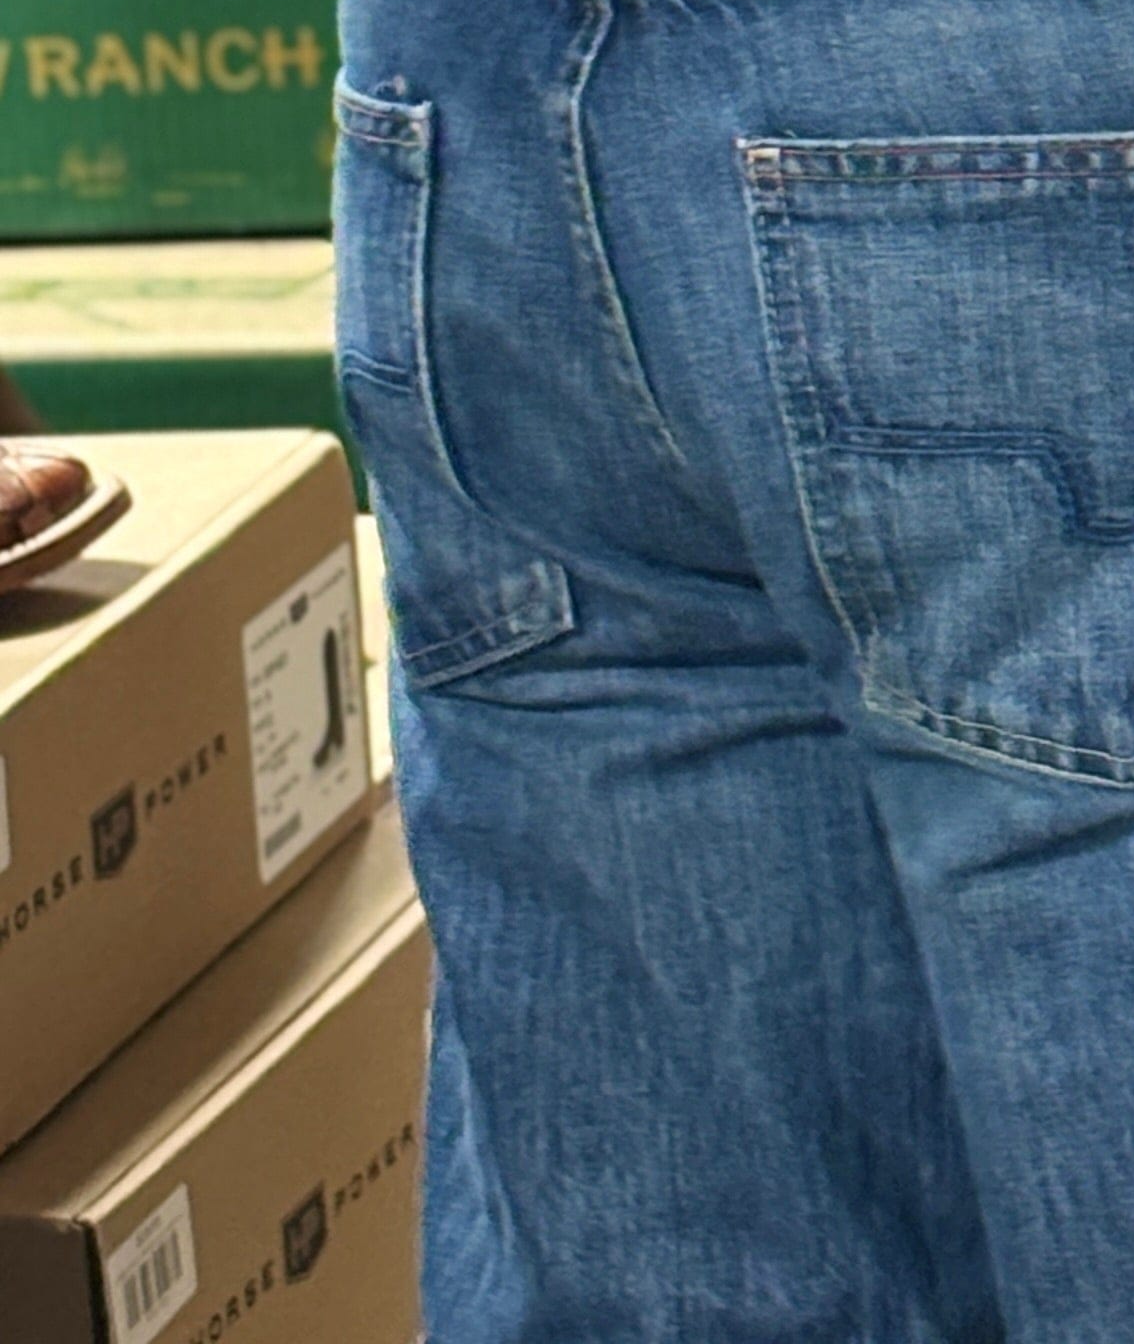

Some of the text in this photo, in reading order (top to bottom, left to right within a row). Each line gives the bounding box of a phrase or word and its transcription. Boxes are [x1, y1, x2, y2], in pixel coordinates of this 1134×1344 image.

[24, 25, 319, 99] RANCH
[145, 731, 227, 822] POWER
[333, 1122, 416, 1216] POWER
